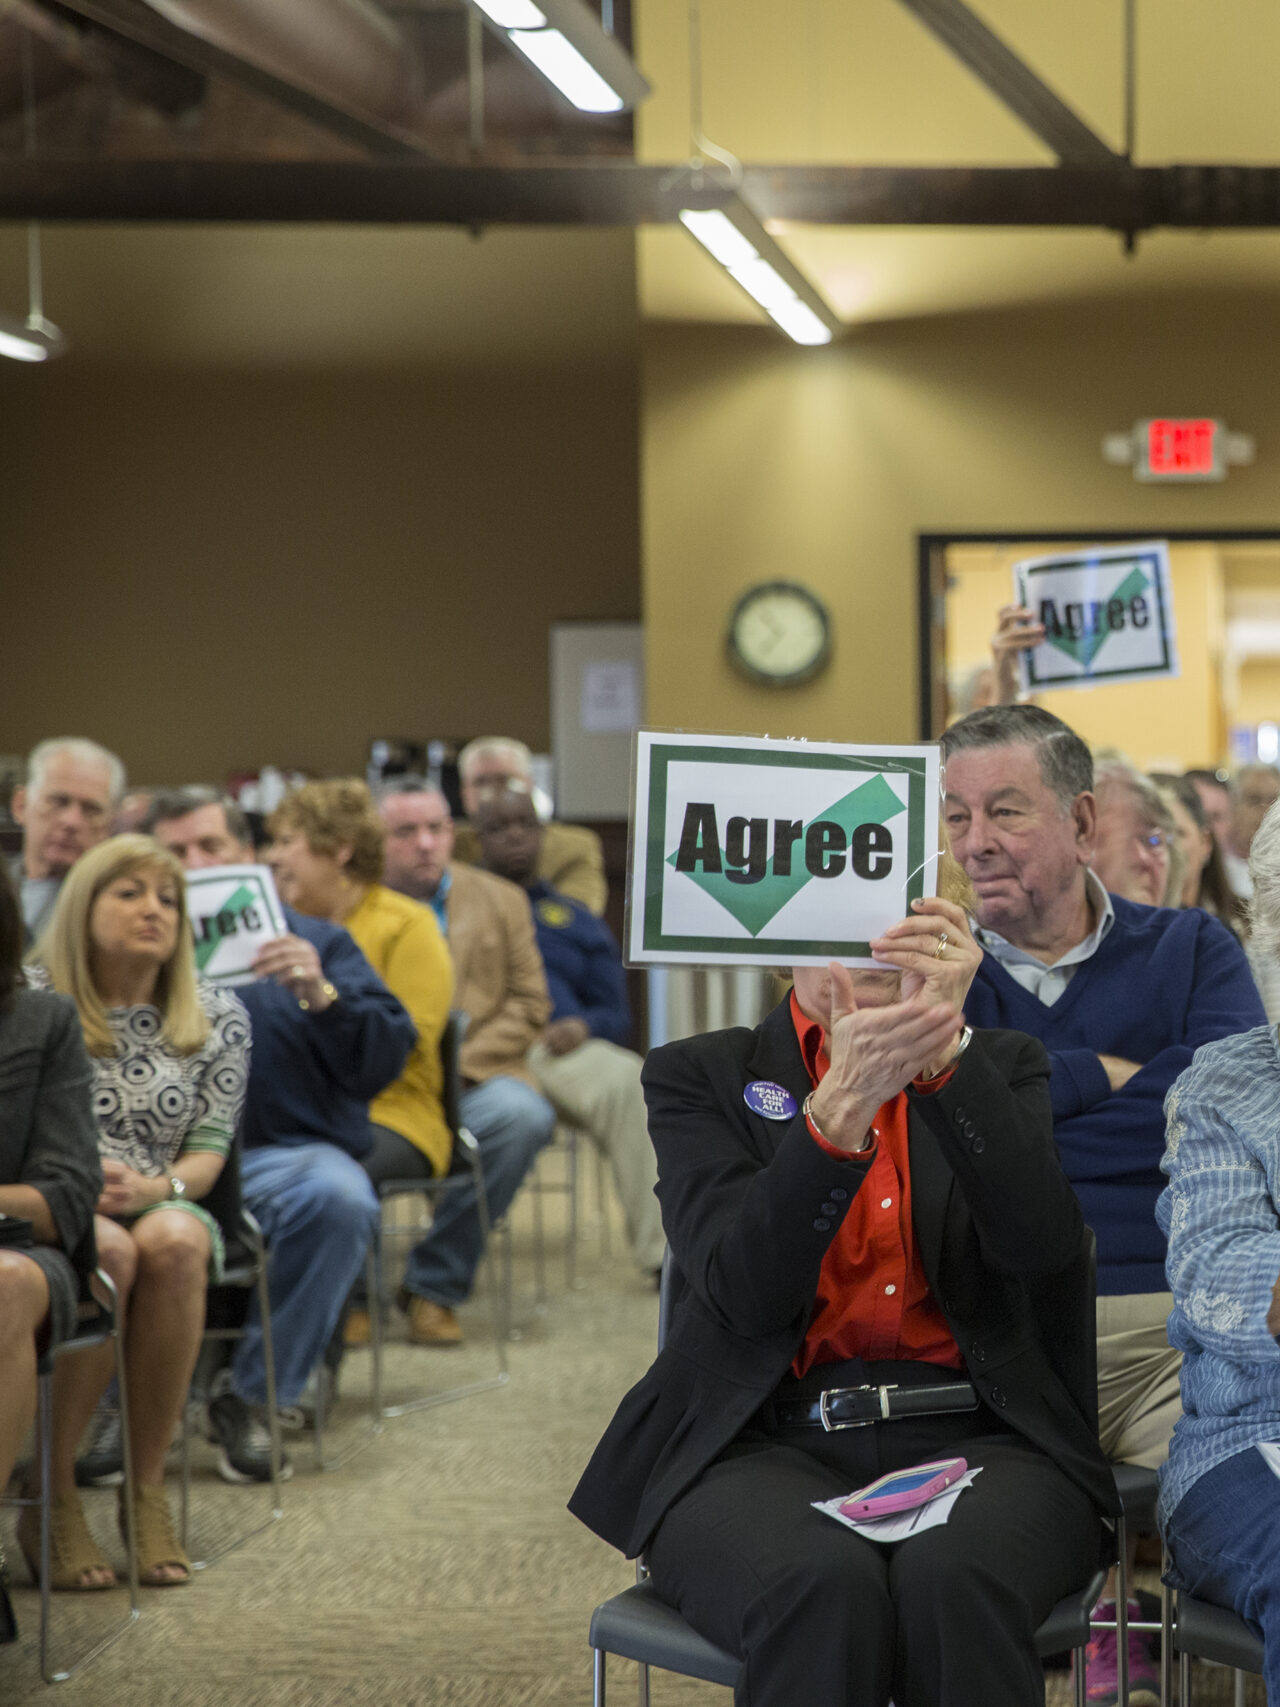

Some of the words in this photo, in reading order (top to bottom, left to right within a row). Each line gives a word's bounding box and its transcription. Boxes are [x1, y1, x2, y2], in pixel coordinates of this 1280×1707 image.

[1148, 419, 1217, 474] EXIT
[1039, 596, 1149, 641] Agree
[675, 802, 893, 884] Agree
[198, 905, 262, 942] ree
[752, 1086, 790, 1099] HEALTH
[758, 1092, 785, 1103] CARE
[762, 1098, 783, 1107] FOR
